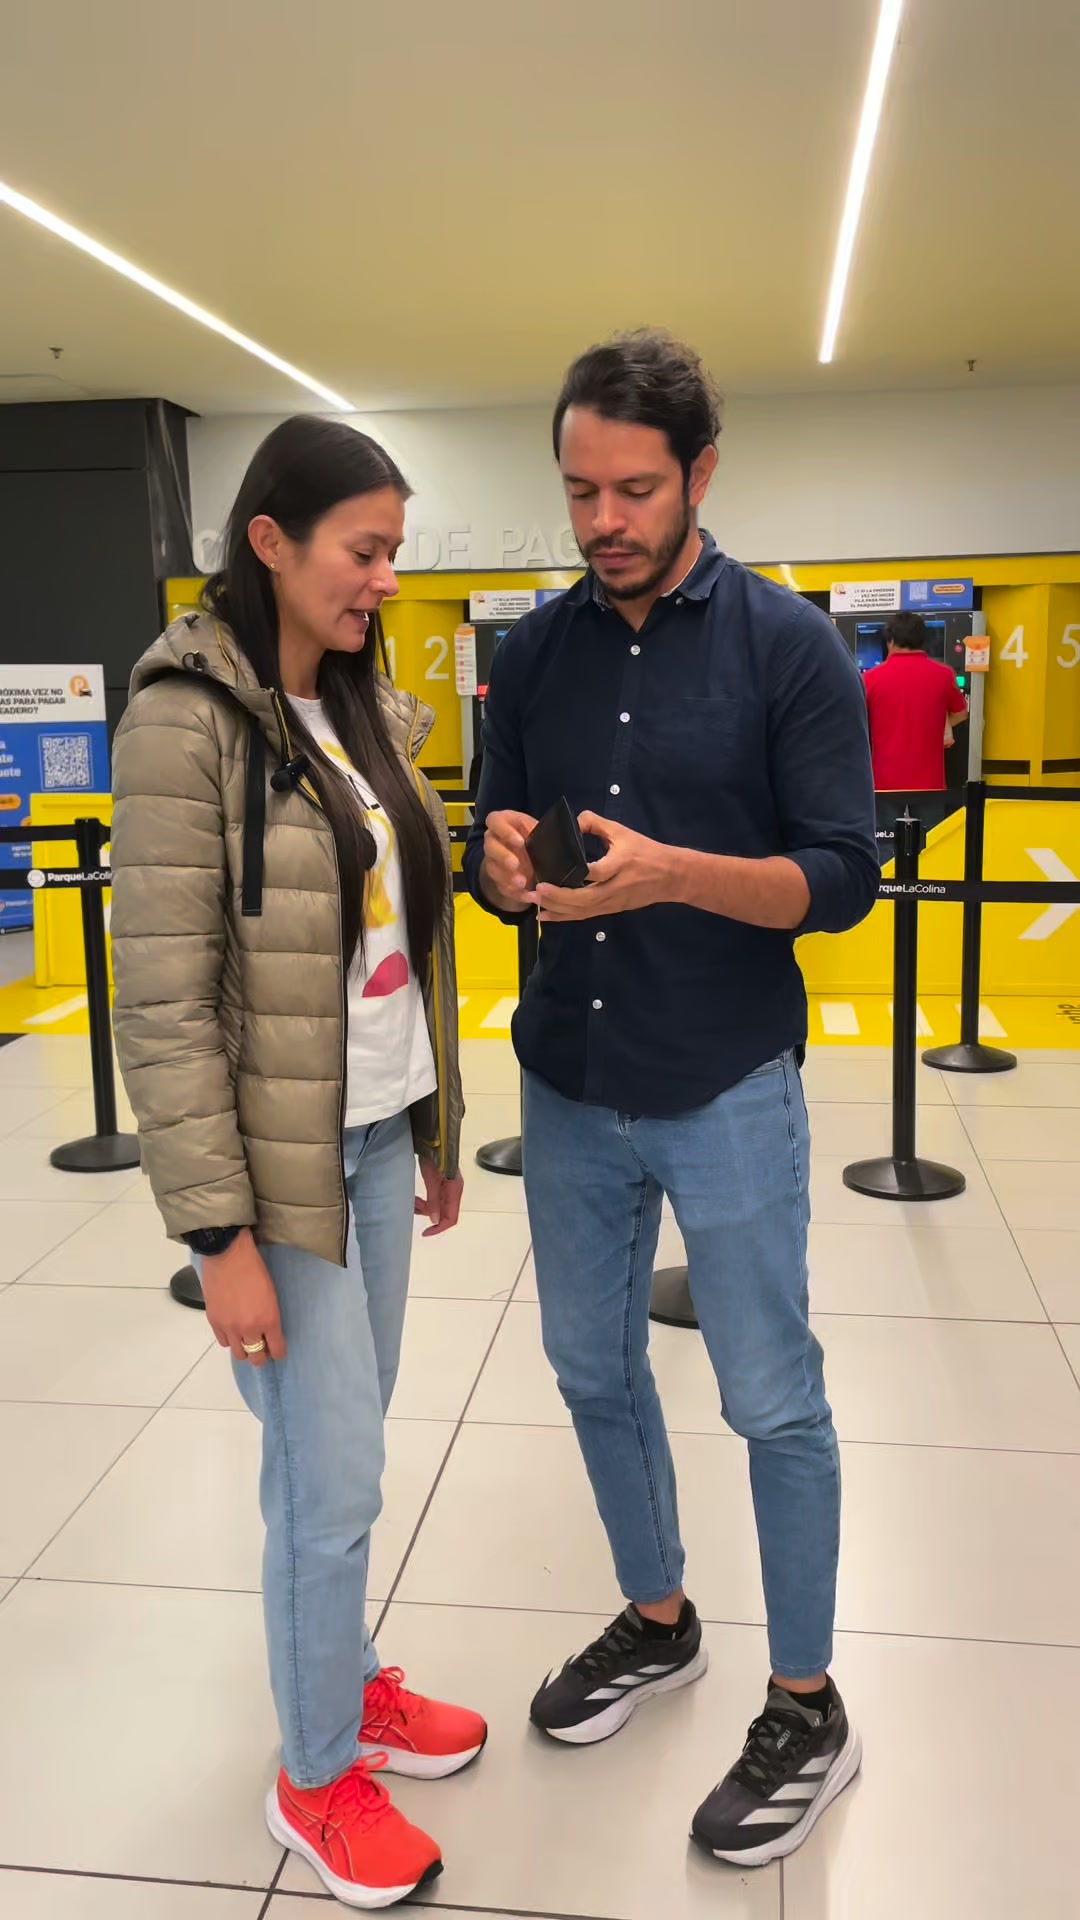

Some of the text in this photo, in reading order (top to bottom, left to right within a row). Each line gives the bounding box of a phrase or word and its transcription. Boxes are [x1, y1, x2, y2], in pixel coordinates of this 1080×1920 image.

[498, 525, 583, 569] PAG
[385, 635, 396, 681] 1
[424, 635, 450, 681] 2
[1000, 625, 1028, 669] 4
[1055, 623, 1080, 669] 5
[13, 697, 36, 705] PARA
[38, 697, 66, 705] PAGAR
[47, 870, 112, 883] ParqueLaColi
[878, 884, 946, 895] rqueLaColina
